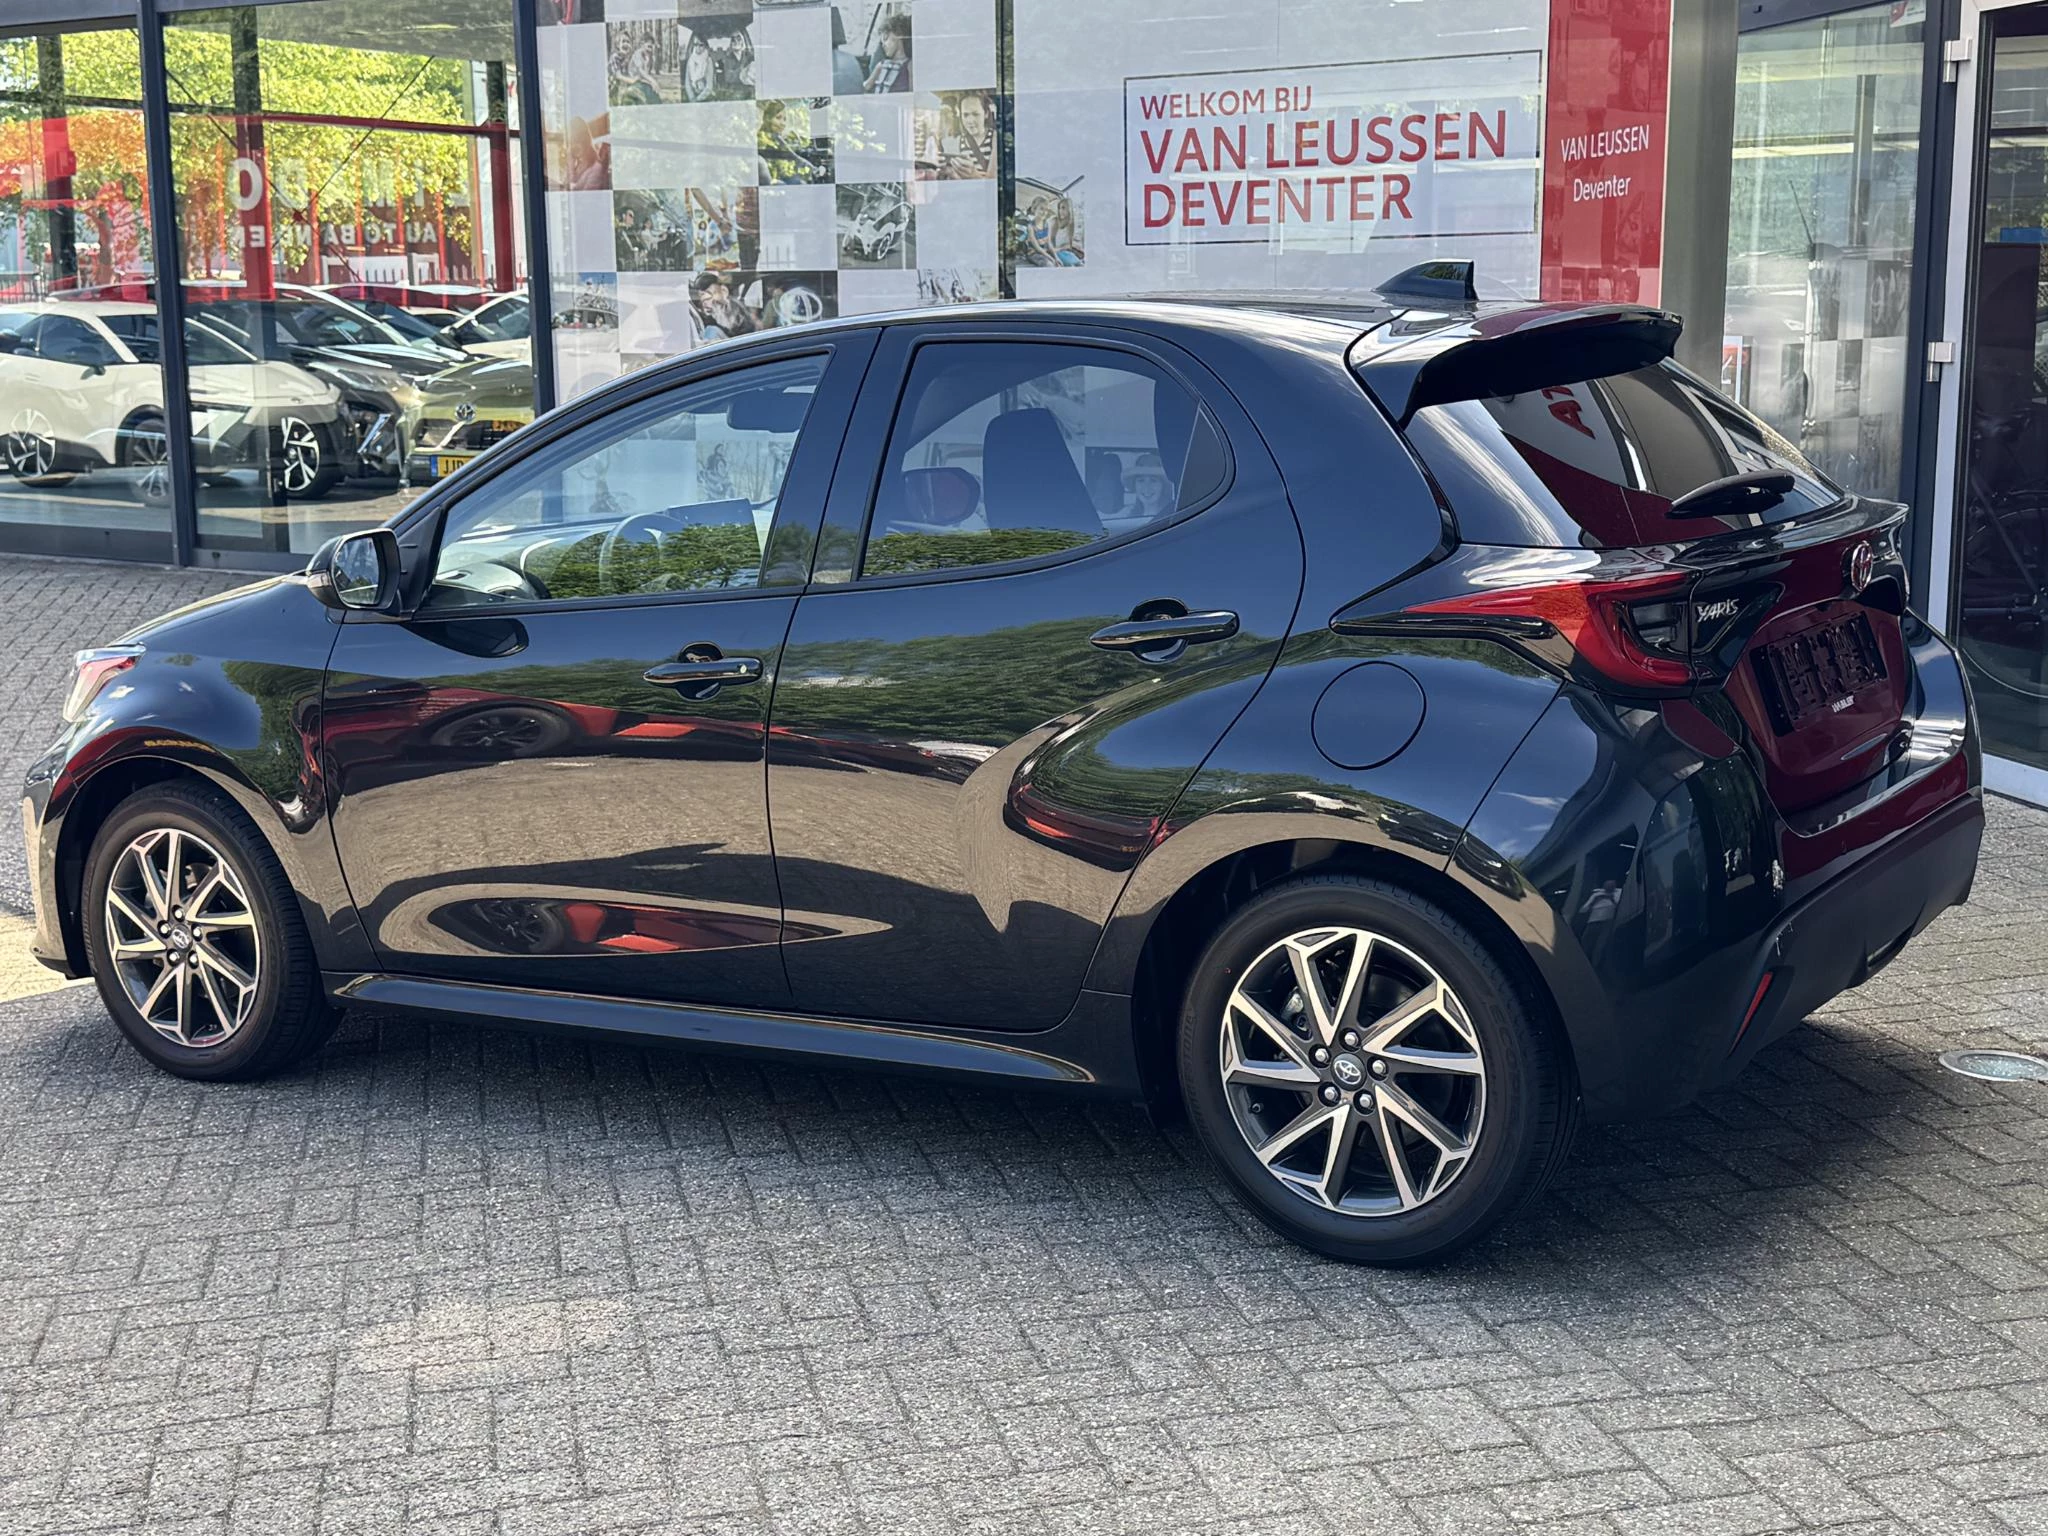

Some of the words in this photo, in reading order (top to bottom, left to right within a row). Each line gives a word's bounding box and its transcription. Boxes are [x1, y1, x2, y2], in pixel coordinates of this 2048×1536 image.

[1140, 88, 1265, 120] WELKOM
[1275, 85, 1312, 113] BIJ
[1140, 125, 1247, 174] VAN
[1266, 110, 1506, 169] LEUSSEN
[1561, 134, 1588, 163] VAN
[1590, 124, 1650, 158] LEUSSEN
[1143, 173, 1413, 228] DEVENTER
[1573, 174, 1631, 202] Deventer
[1697, 598, 1740, 623] YARIS
